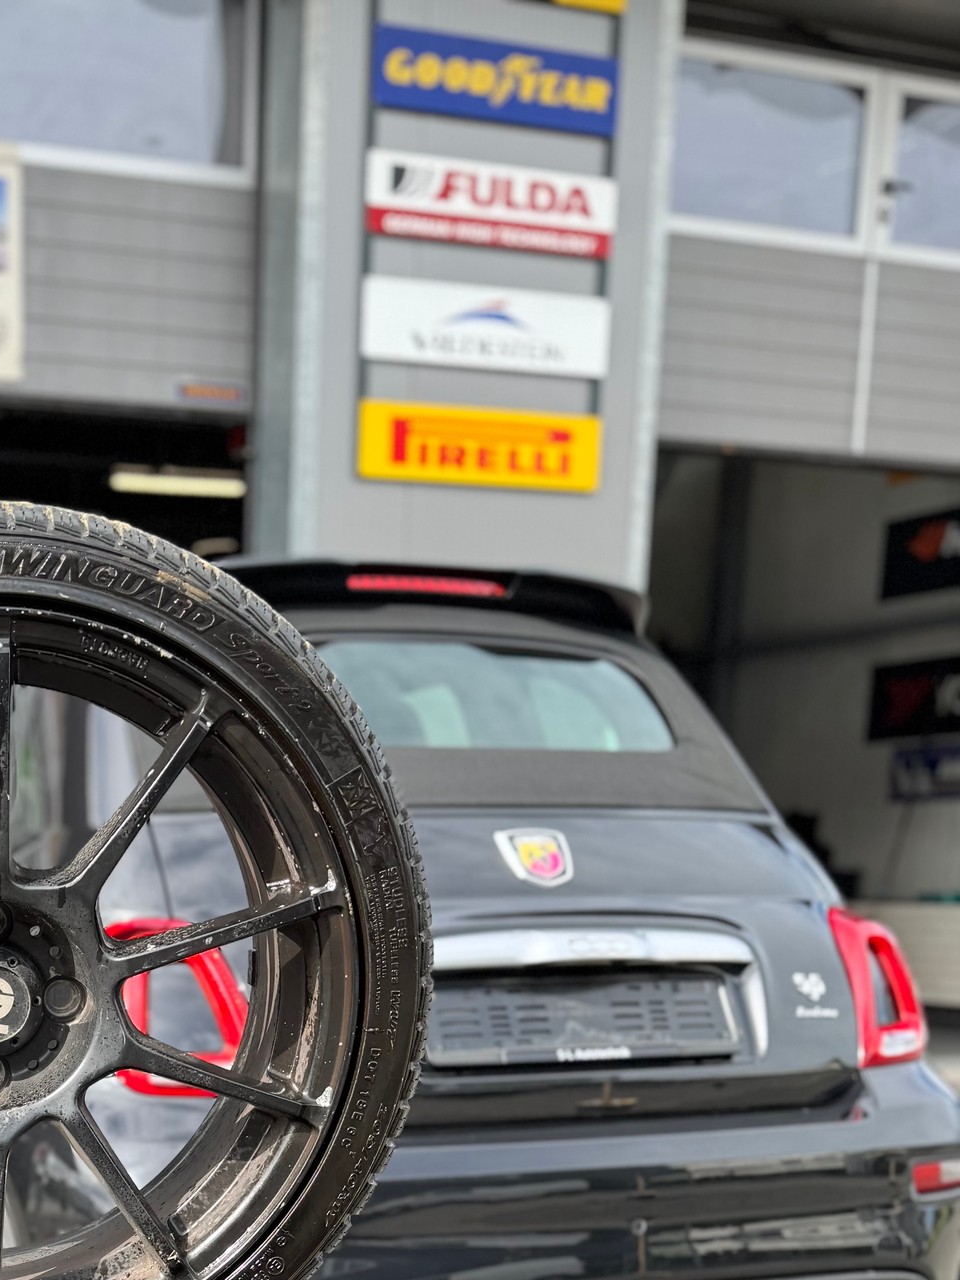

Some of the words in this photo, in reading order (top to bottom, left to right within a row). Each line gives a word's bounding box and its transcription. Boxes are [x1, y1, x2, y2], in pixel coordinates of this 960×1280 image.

[383, 48, 613, 113] GOODYEAR
[434, 169, 593, 218] FULDA
[389, 417, 573, 476] PIRELLI
[0, 548, 227, 632] WINGUARD
[227, 629, 299, 700] Sport
[385, 865, 408, 947] STUDLESS
